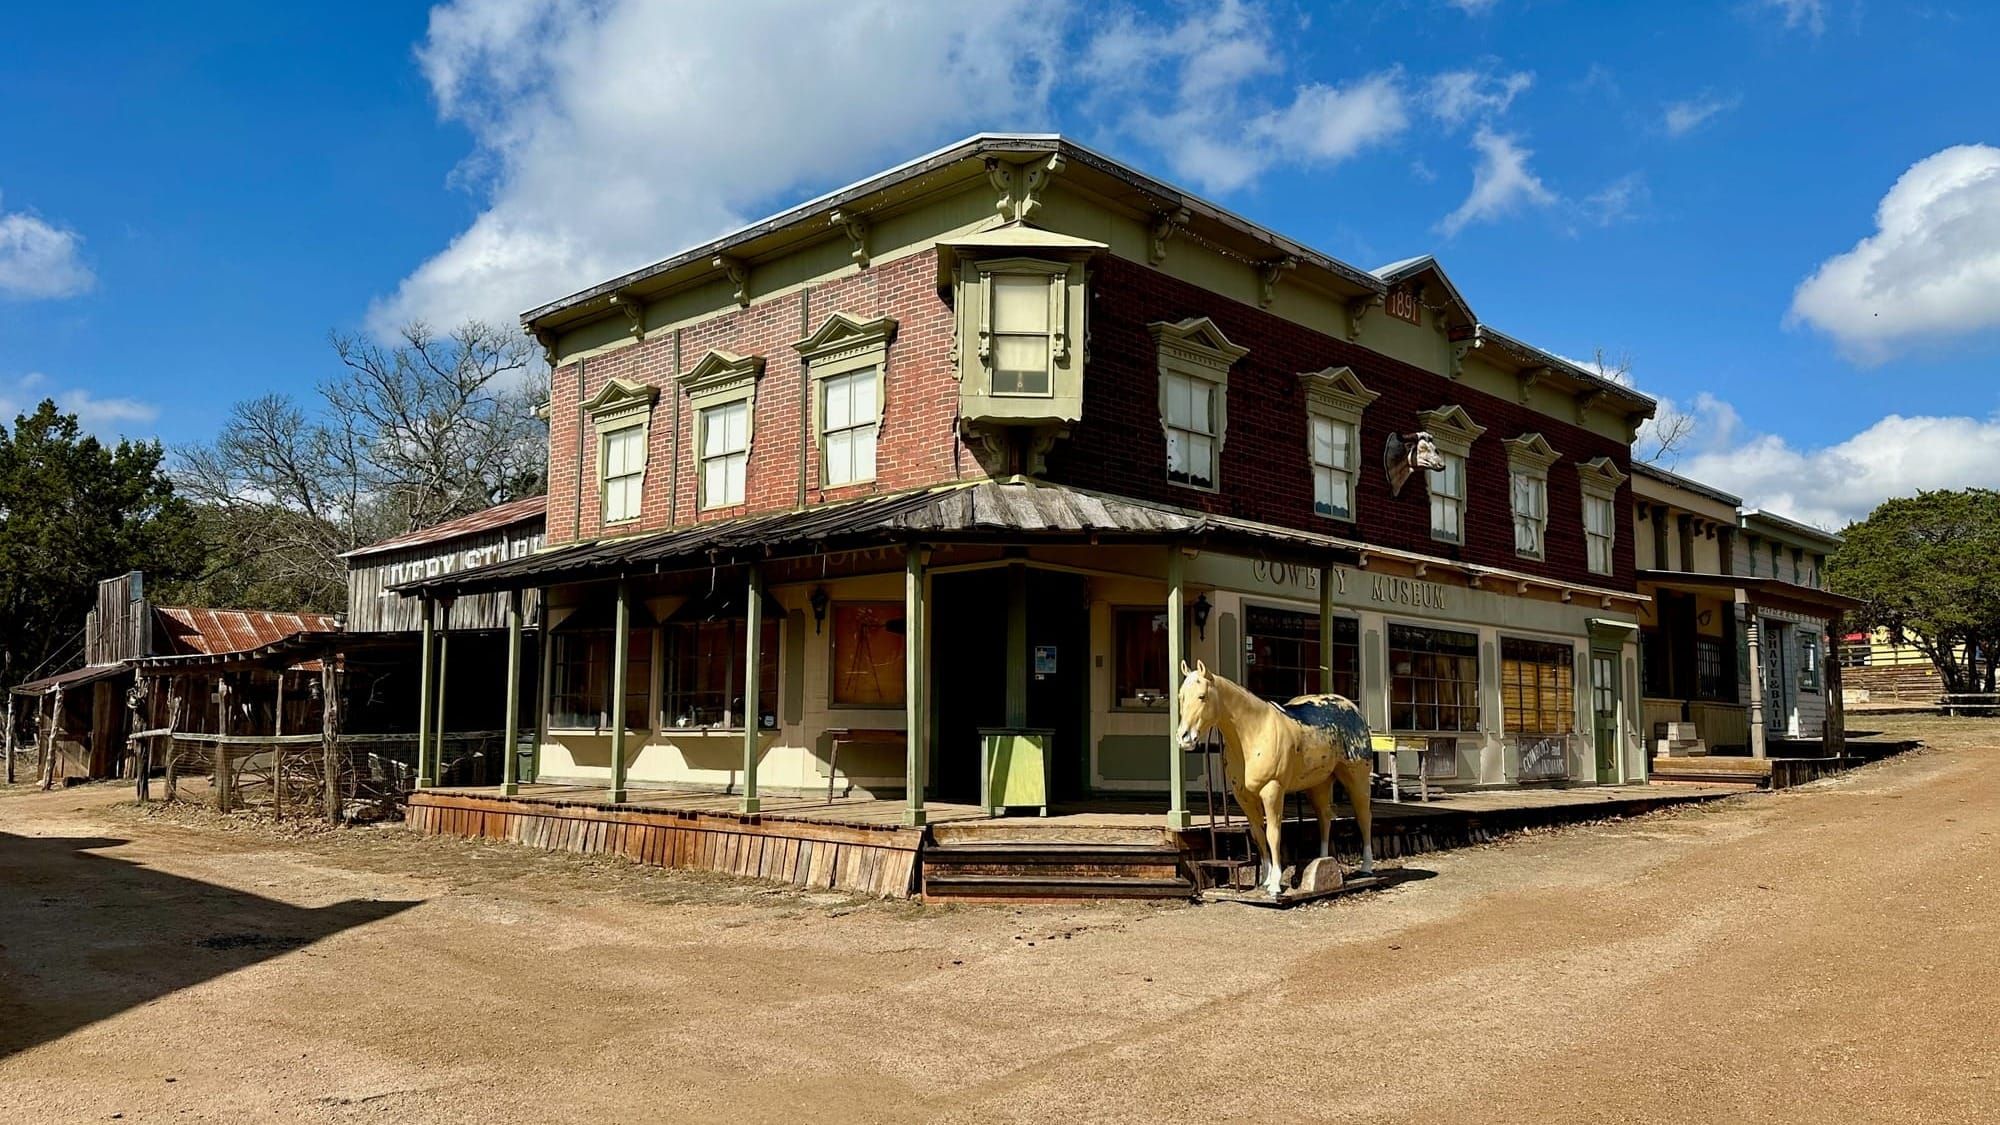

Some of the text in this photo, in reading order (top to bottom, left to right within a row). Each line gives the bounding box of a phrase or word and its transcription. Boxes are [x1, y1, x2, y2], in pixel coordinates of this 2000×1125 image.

[1391, 291, 1416, 321] 1891
[378, 554, 456, 598] LIVERY
[1253, 559, 1446, 610] COWBY MUSEUM
